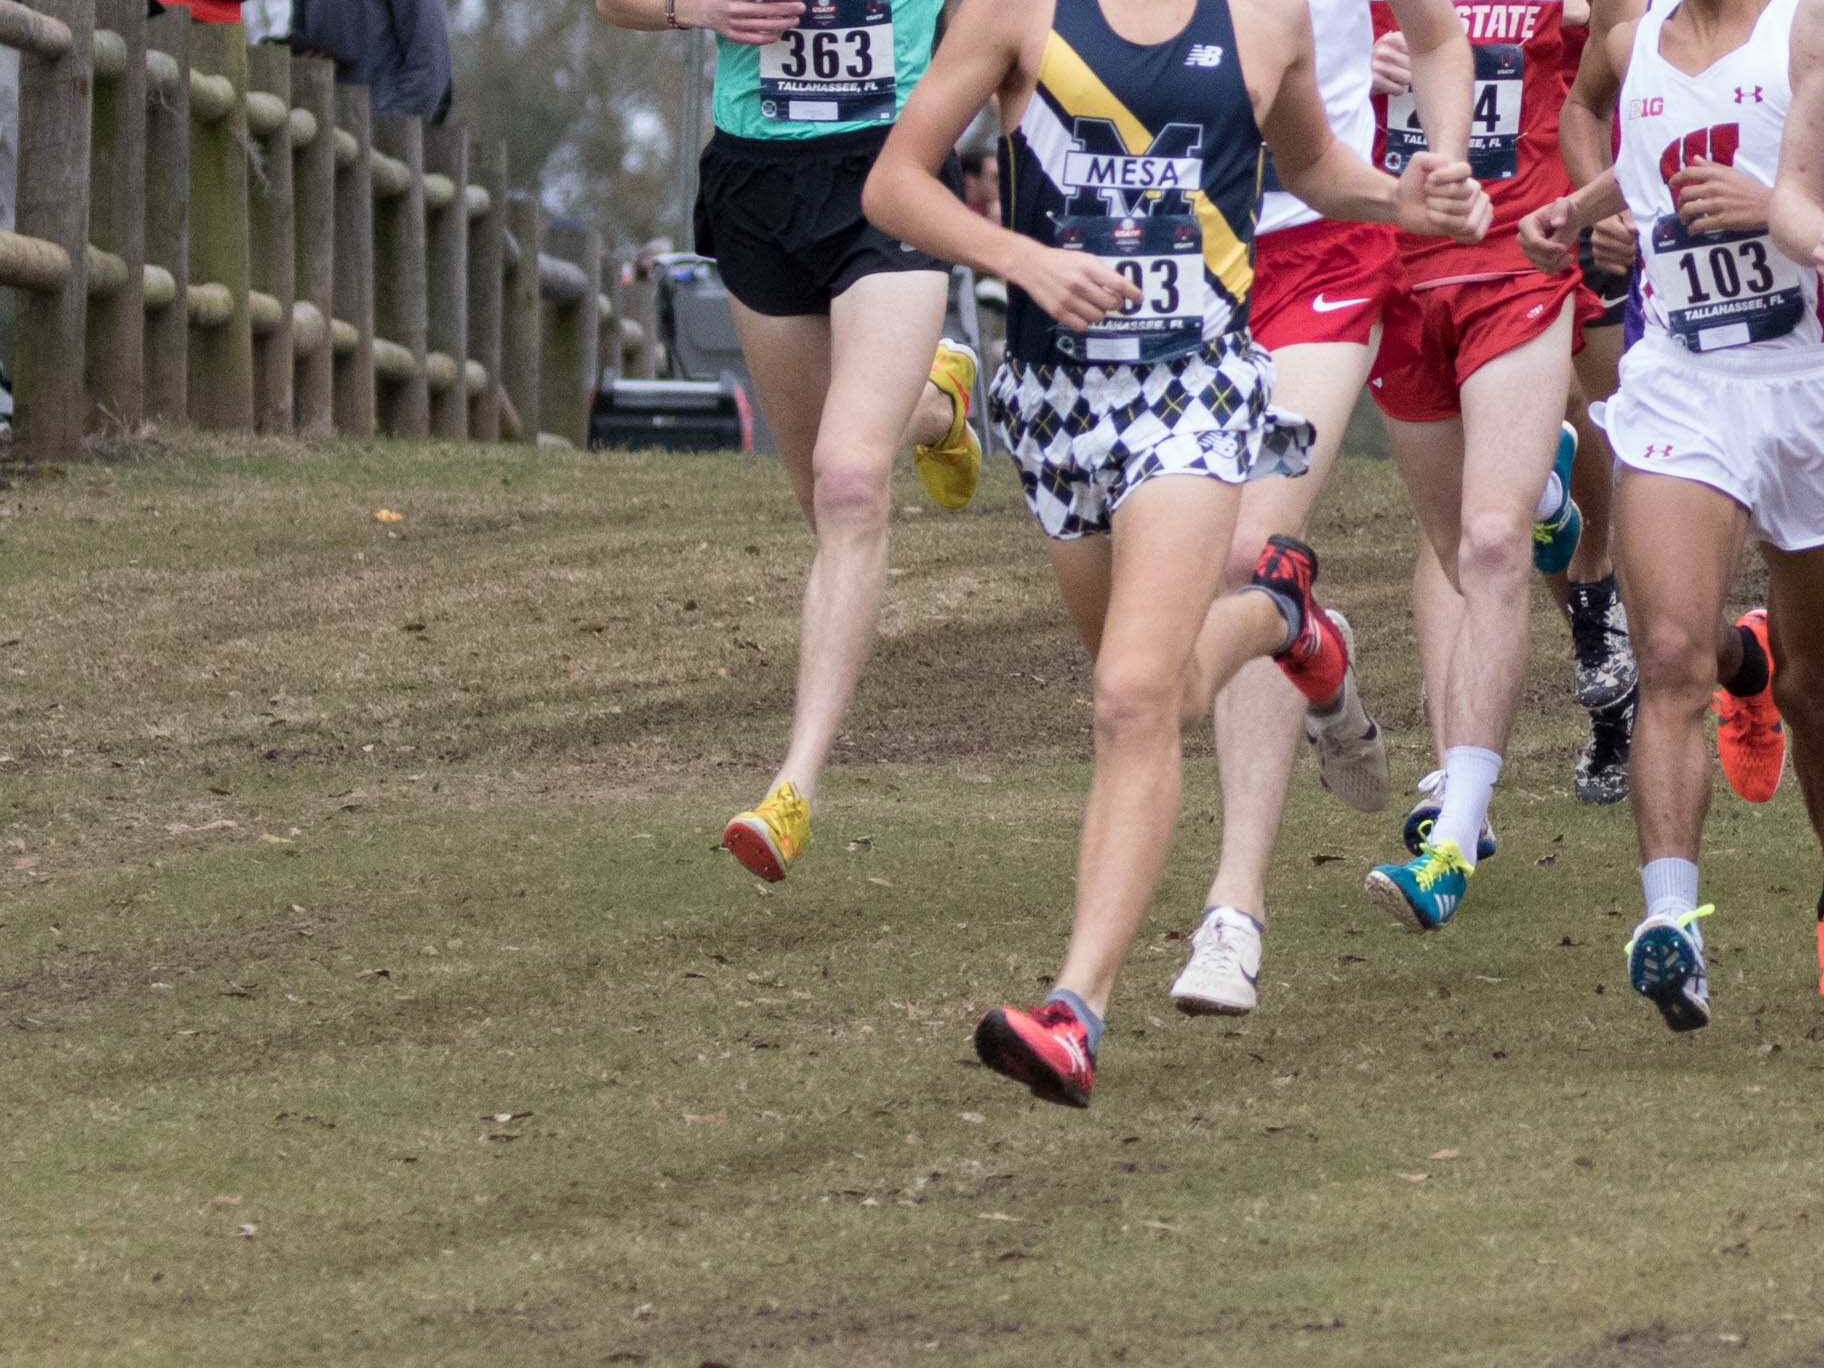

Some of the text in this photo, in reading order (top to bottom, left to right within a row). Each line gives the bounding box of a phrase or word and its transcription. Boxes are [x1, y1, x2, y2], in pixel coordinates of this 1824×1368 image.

[780, 29, 873, 79] 363
[777, 81, 878, 93] TALLAHASSEE, FL
[1087, 157, 1178, 186] MESA
[1679, 241, 1774, 304] 103
[1685, 294, 1785, 321] TALLAHASSEE, FL
